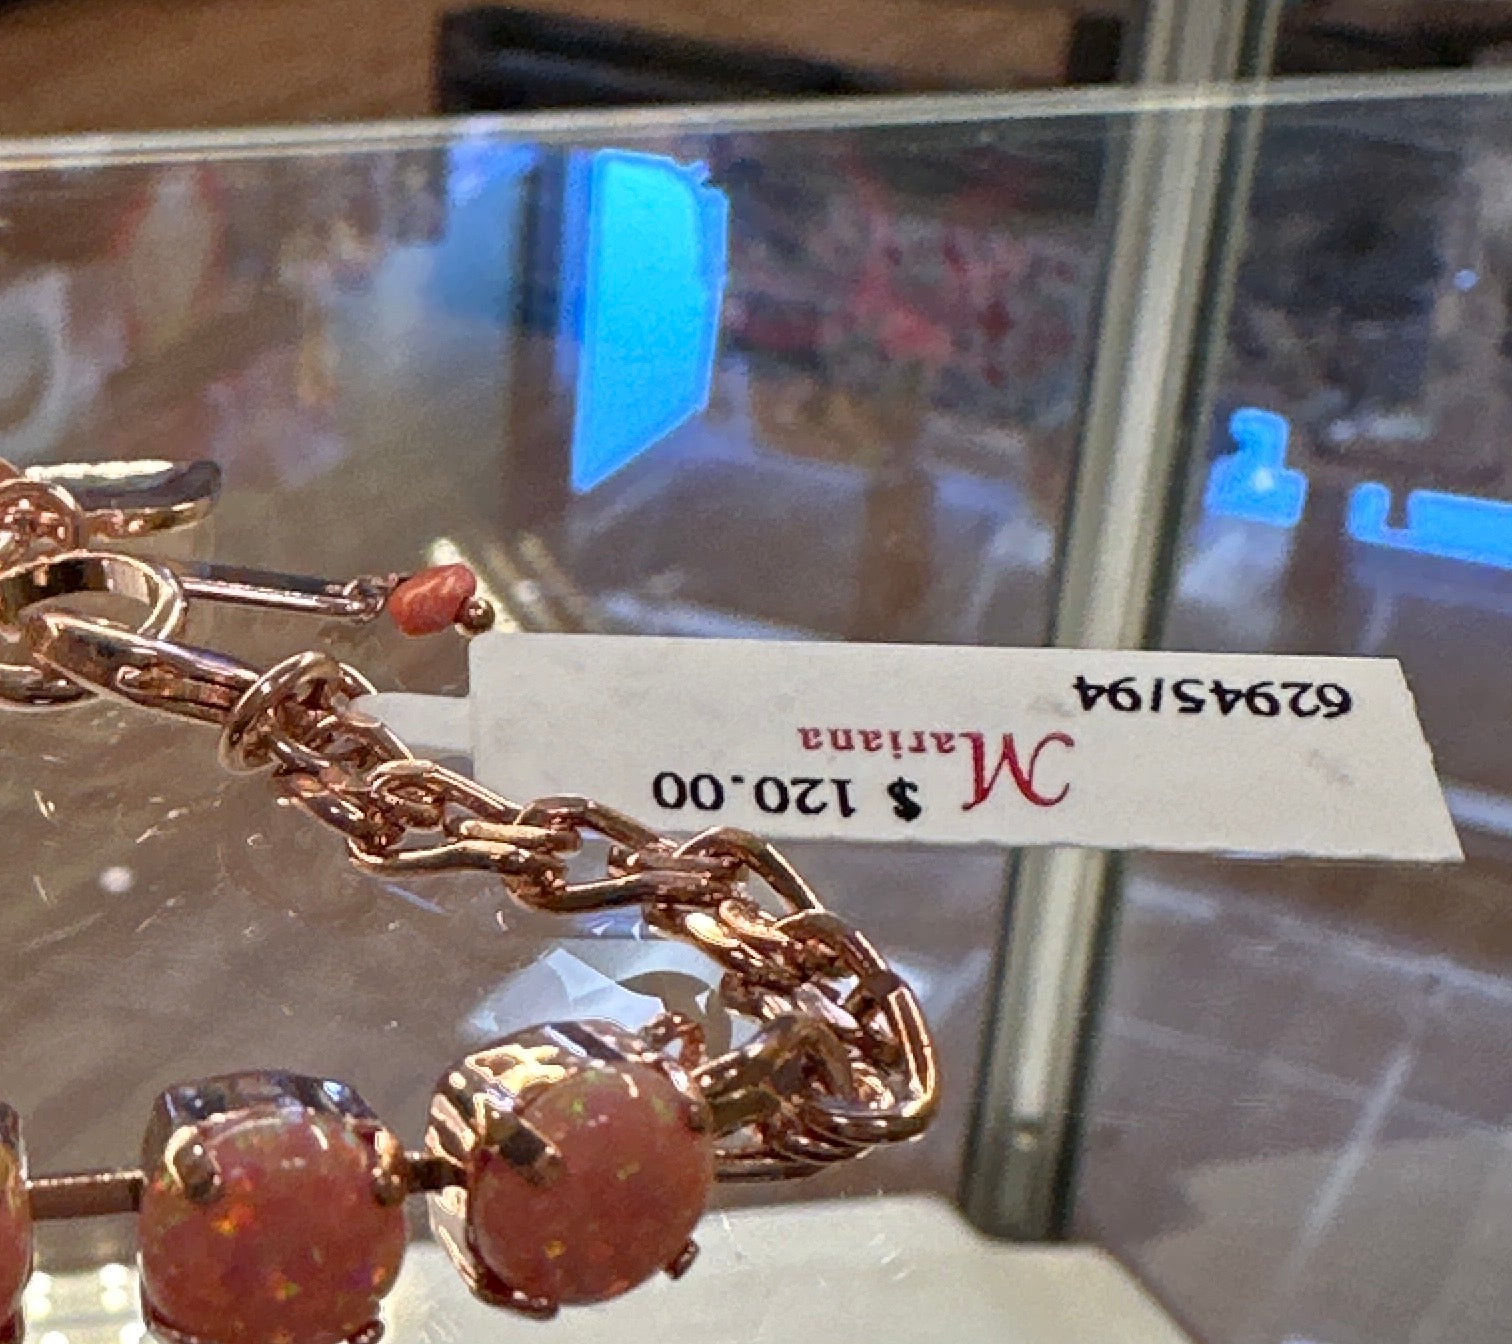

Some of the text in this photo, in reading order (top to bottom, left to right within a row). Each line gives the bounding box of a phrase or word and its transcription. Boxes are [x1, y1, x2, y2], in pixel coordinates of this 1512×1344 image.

[652, 770, 923, 823] $ 120.00
[797, 726, 1075, 812] Mariana
